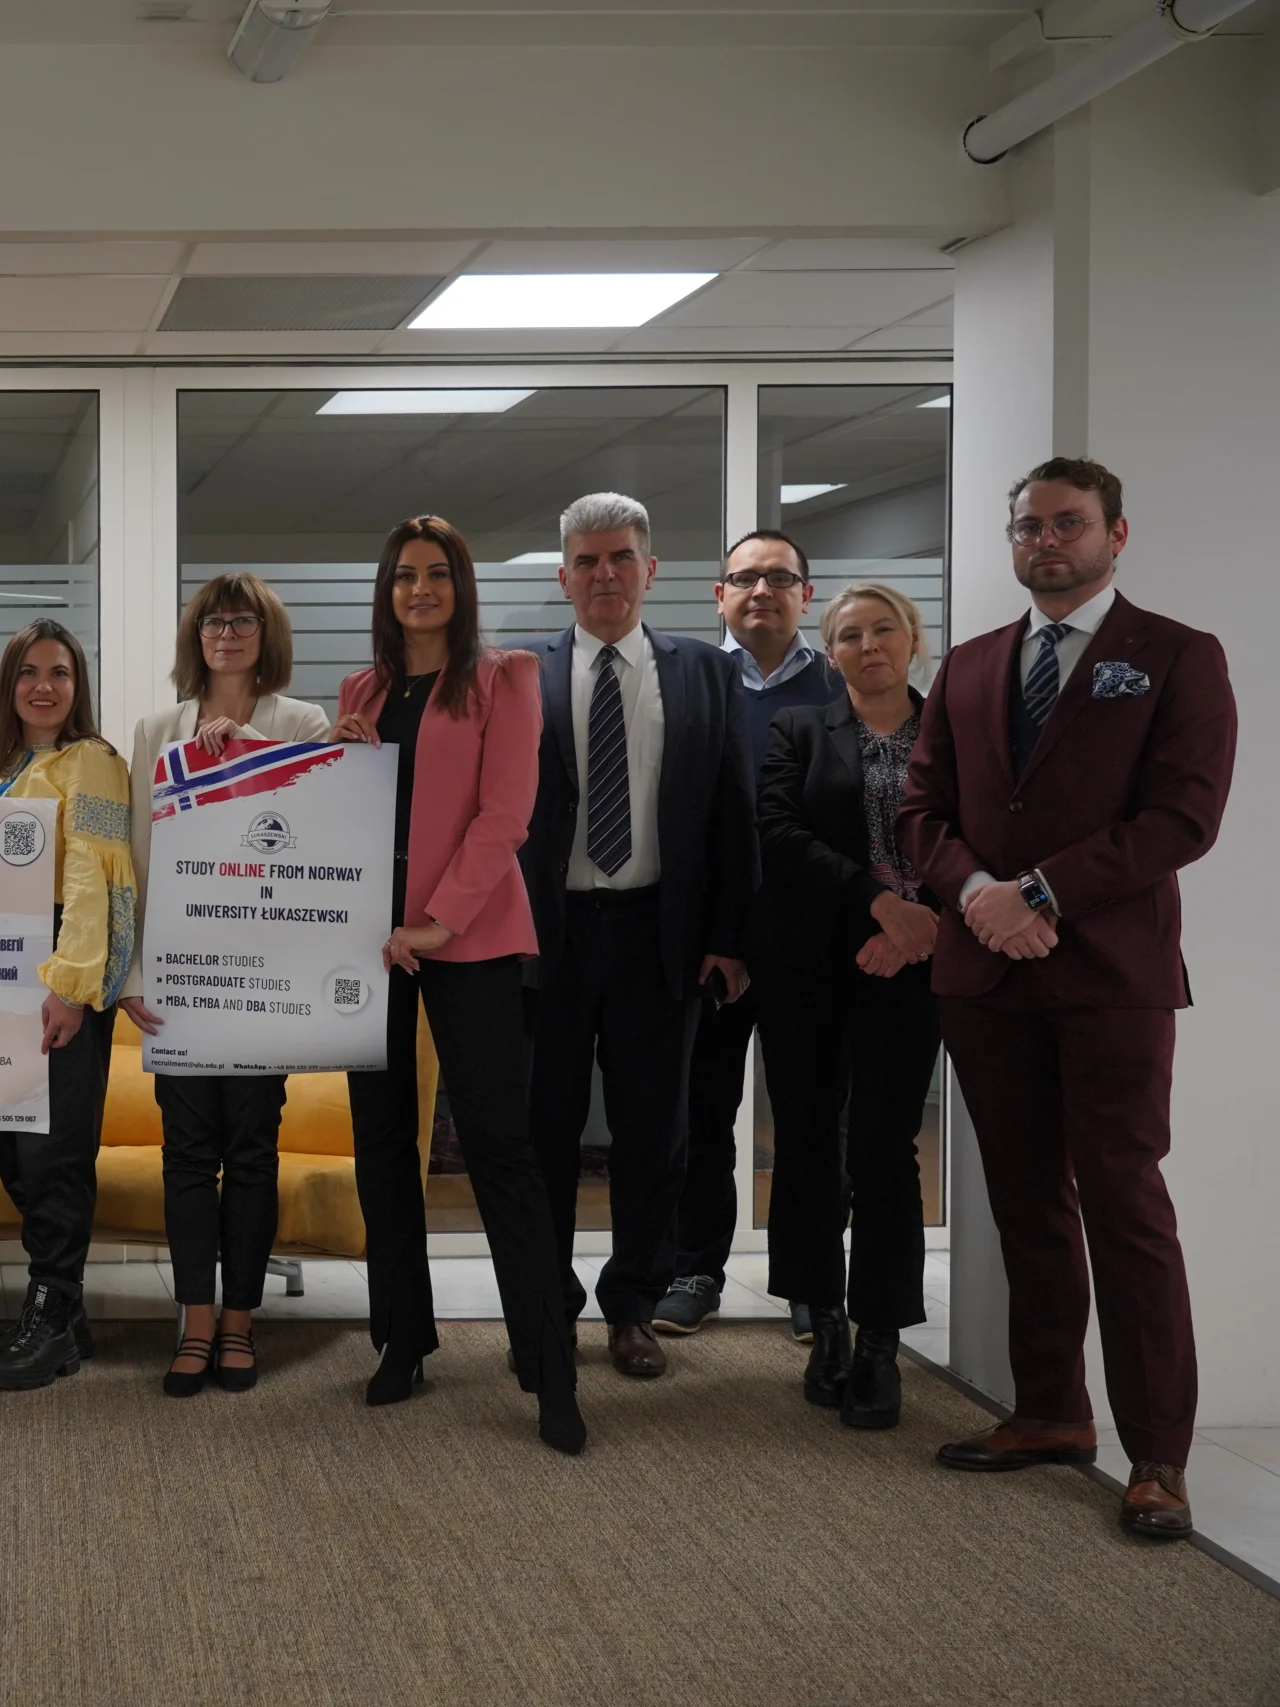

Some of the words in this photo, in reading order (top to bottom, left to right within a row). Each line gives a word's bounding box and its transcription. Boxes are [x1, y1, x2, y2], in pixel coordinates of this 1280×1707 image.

[176, 860, 215, 875] STUDY
[219, 862, 266, 878] ONLINE
[269, 864, 304, 879] FROM
[308, 866, 362, 881] NORWAY
[260, 886, 273, 899] IN
[186, 904, 257, 919] UNIVERSITY
[260, 907, 348, 923] ŁUKASZEWSKI
[166, 953, 219, 966] BACHELOR
[222, 955, 264, 968] STUDIES
[166, 974, 245, 988] POSTGRADUATE
[248, 977, 291, 991] STUDIES
[166, 995, 190, 1008] MBA,
[193, 997, 220, 1009] EMBA
[223, 999, 243, 1011] AND
[246, 1000, 266, 1012] DBA
[269, 1001, 311, 1015] STUDIES
[151, 1047, 176, 1055] Contact
[151, 1060, 224, 1070] recruitment@ulu.edu.pl
